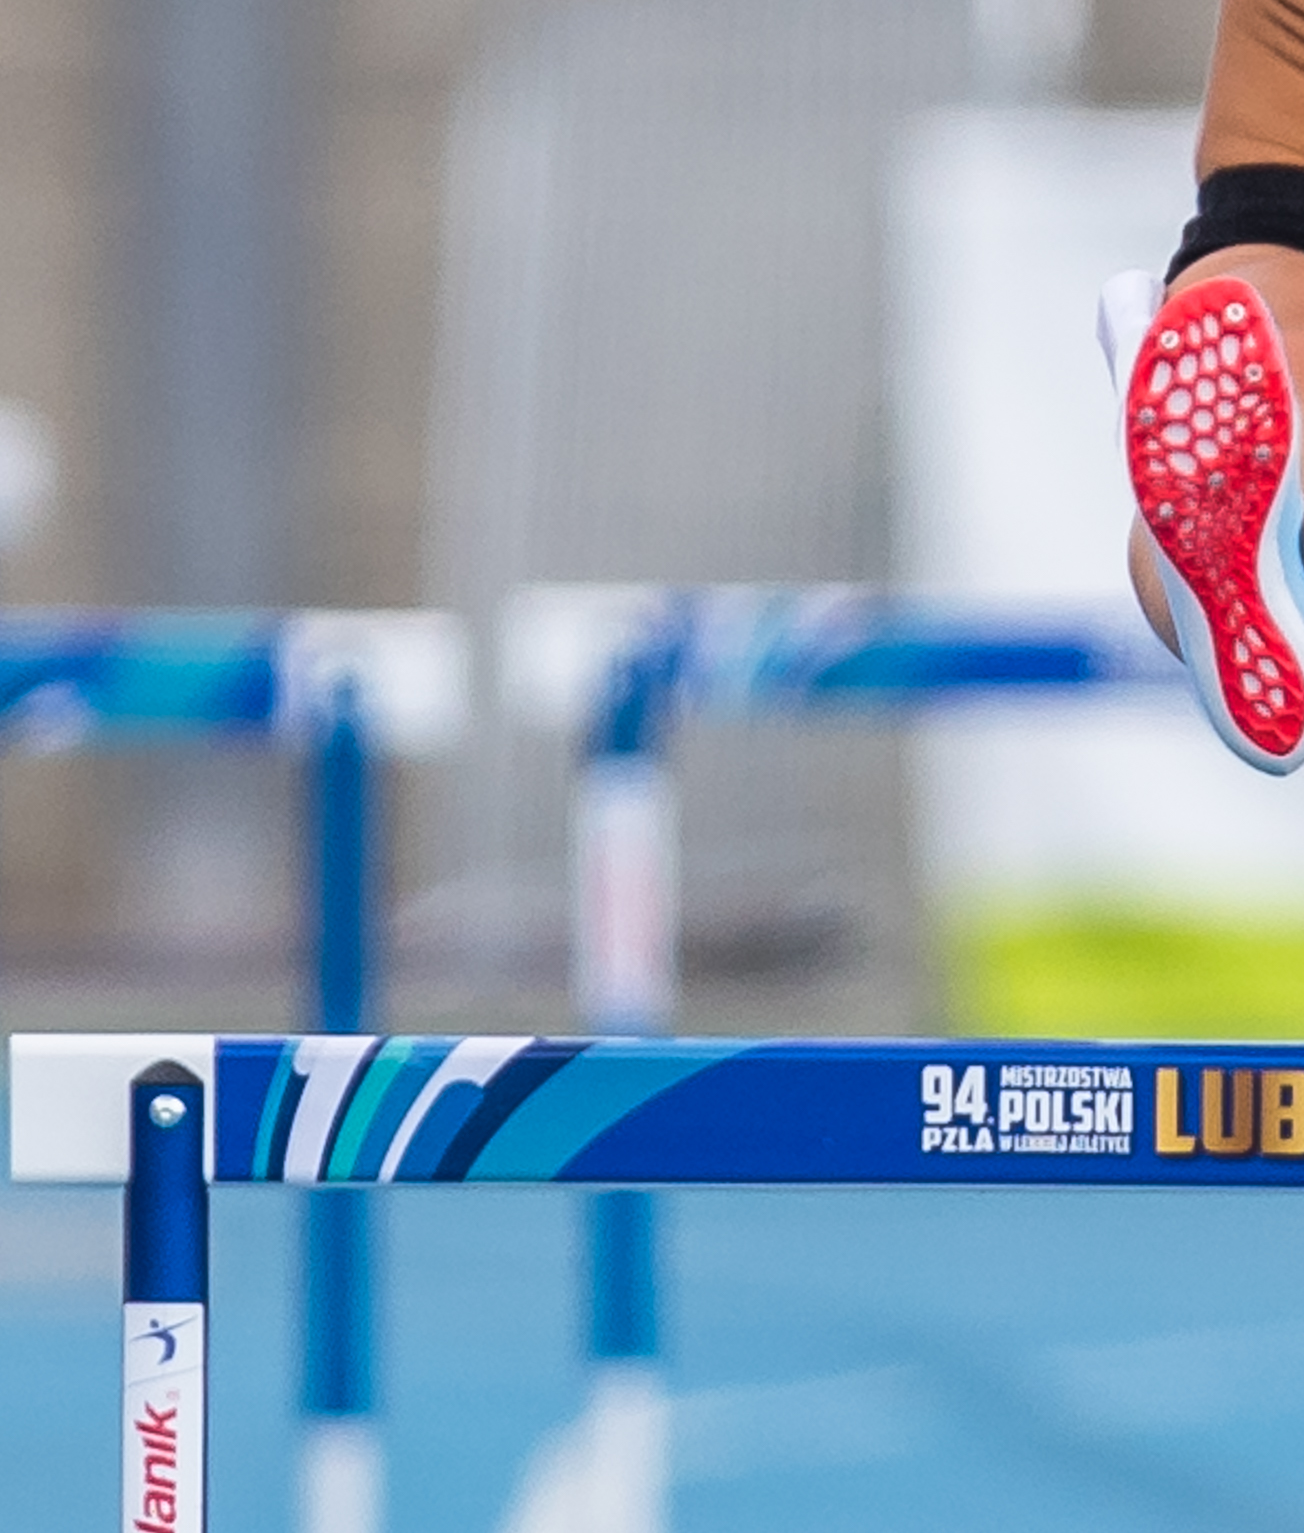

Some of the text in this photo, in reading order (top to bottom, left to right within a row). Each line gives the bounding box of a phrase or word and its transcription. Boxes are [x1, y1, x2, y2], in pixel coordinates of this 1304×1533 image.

[999, 1065, 1133, 1089] MISTRZOSTWA
[998, 1089, 1134, 1134] POLSKI
[921, 1126, 995, 1153] PZLA
